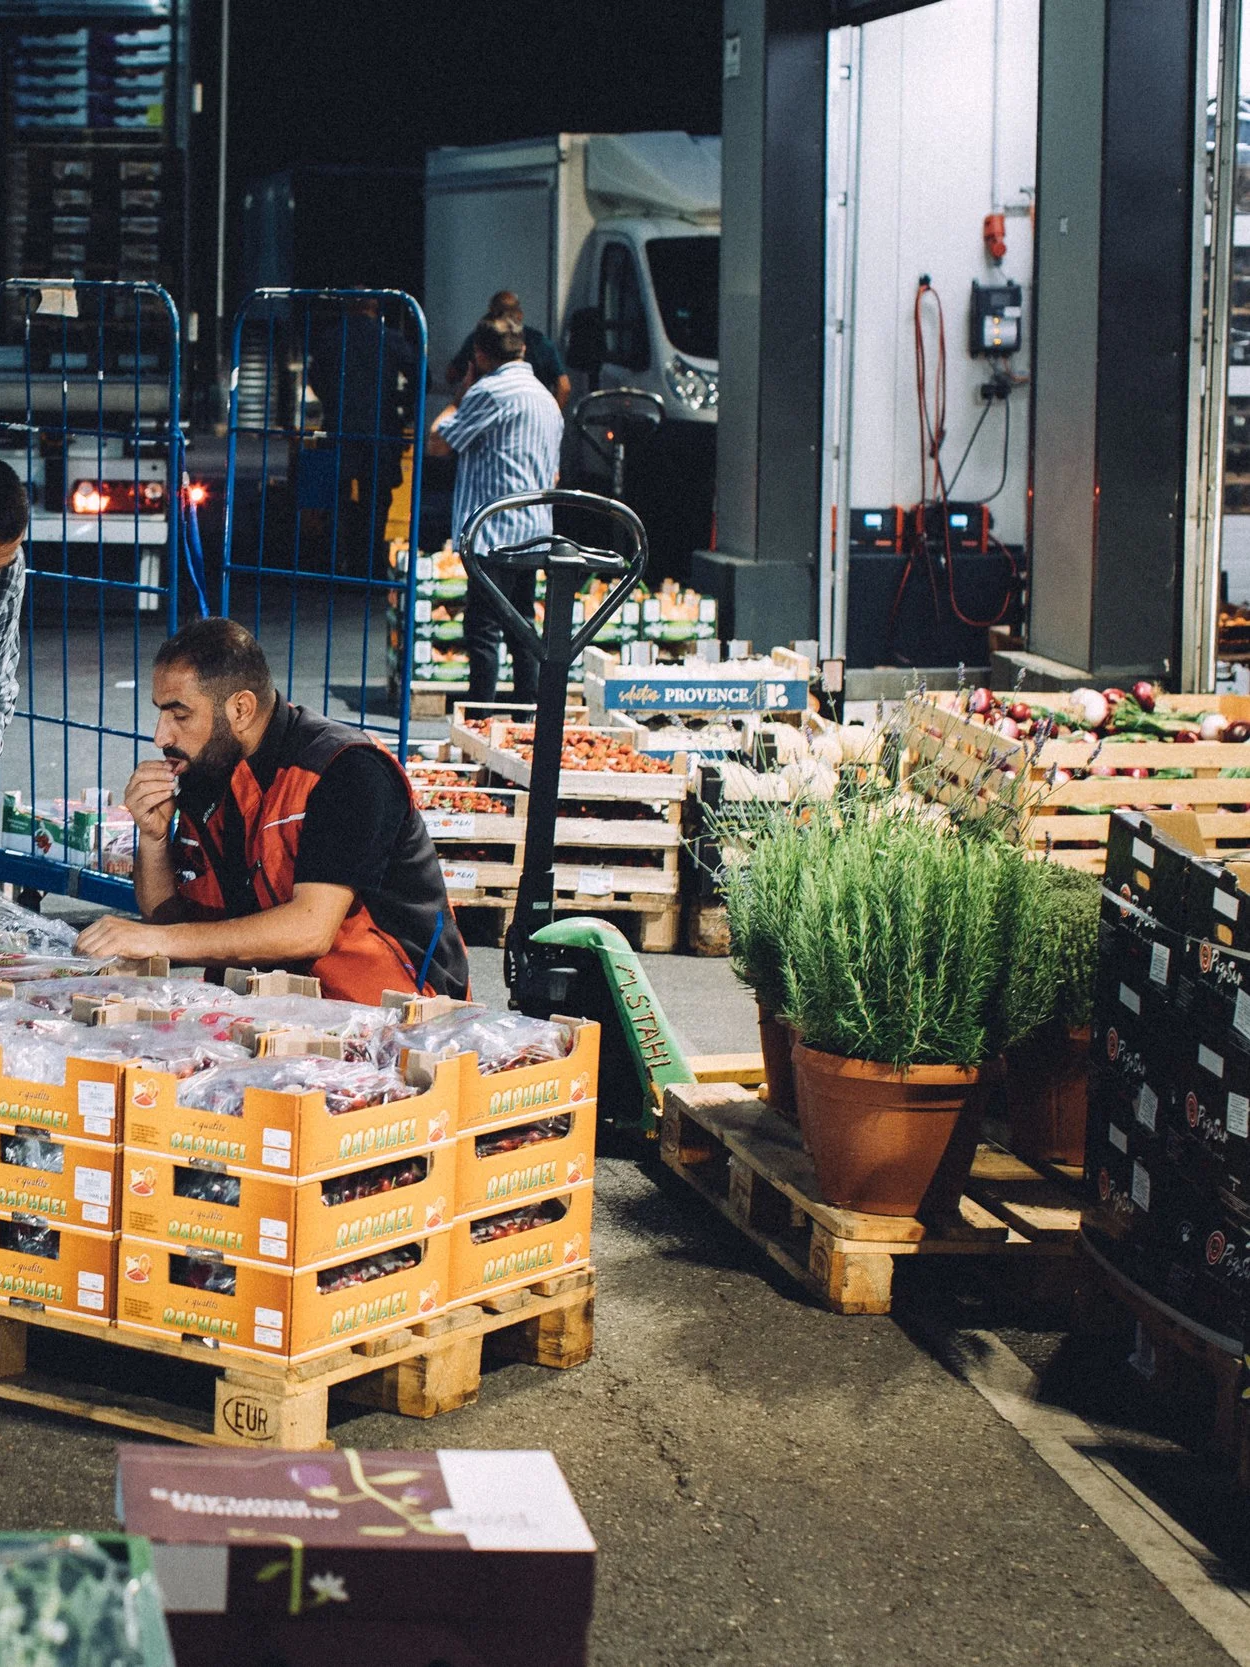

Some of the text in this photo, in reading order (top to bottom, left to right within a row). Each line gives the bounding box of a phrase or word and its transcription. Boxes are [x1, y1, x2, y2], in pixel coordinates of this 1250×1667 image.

[664, 687, 749, 703] PROVENCE
[626, 994, 671, 1082] STAHL
[489, 1079, 560, 1117] RAPHAEL
[170, 1131, 246, 1161] RAPHAEL
[338, 1118, 417, 1160] RAPHAEL
[486, 1160, 558, 1201] RAPHAEL
[167, 1219, 244, 1250] RAPHAEL
[335, 1204, 414, 1250] RAPHAEL
[481, 1241, 554, 1285] RAPHAEL
[162, 1307, 239, 1339] RAPHAEL
[330, 1290, 408, 1337] RAPHAEL
[235, 1401, 268, 1434] EUR
